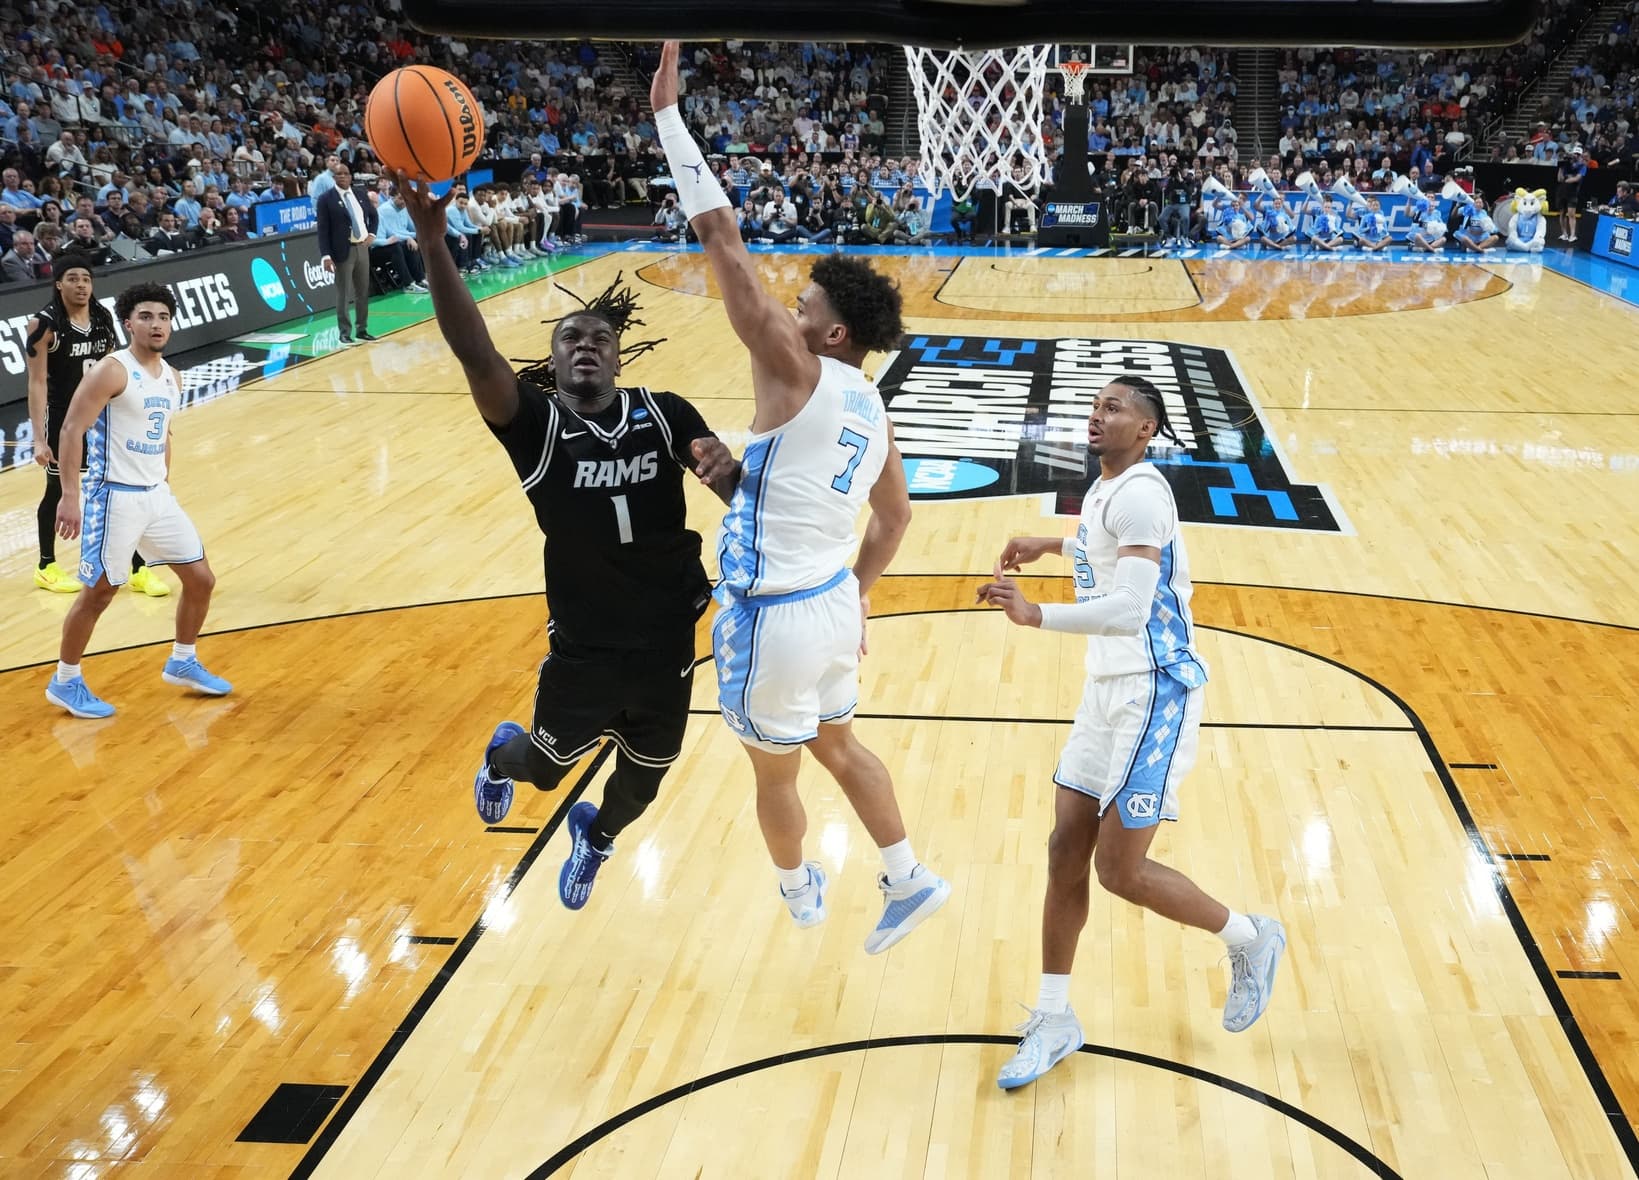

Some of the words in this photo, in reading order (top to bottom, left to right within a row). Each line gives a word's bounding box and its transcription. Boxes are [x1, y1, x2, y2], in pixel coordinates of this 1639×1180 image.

[443, 80, 476, 159] Wilson
[1056, 204, 1084, 214] MARCH
[1058, 214, 1097, 223] MADNESS
[170, 272, 240, 332] LETES
[146, 411, 165, 440] 3
[886, 365, 1034, 460] MARCH
[126, 438, 165, 455] CAROLI
[831, 427, 869, 494] 7
[573, 450, 658, 488] RAMS
[909, 459, 959, 490] NCAA
[610, 494, 633, 544] 1
[1073, 547, 1096, 589] 5
[538, 726, 558, 746] VCU
